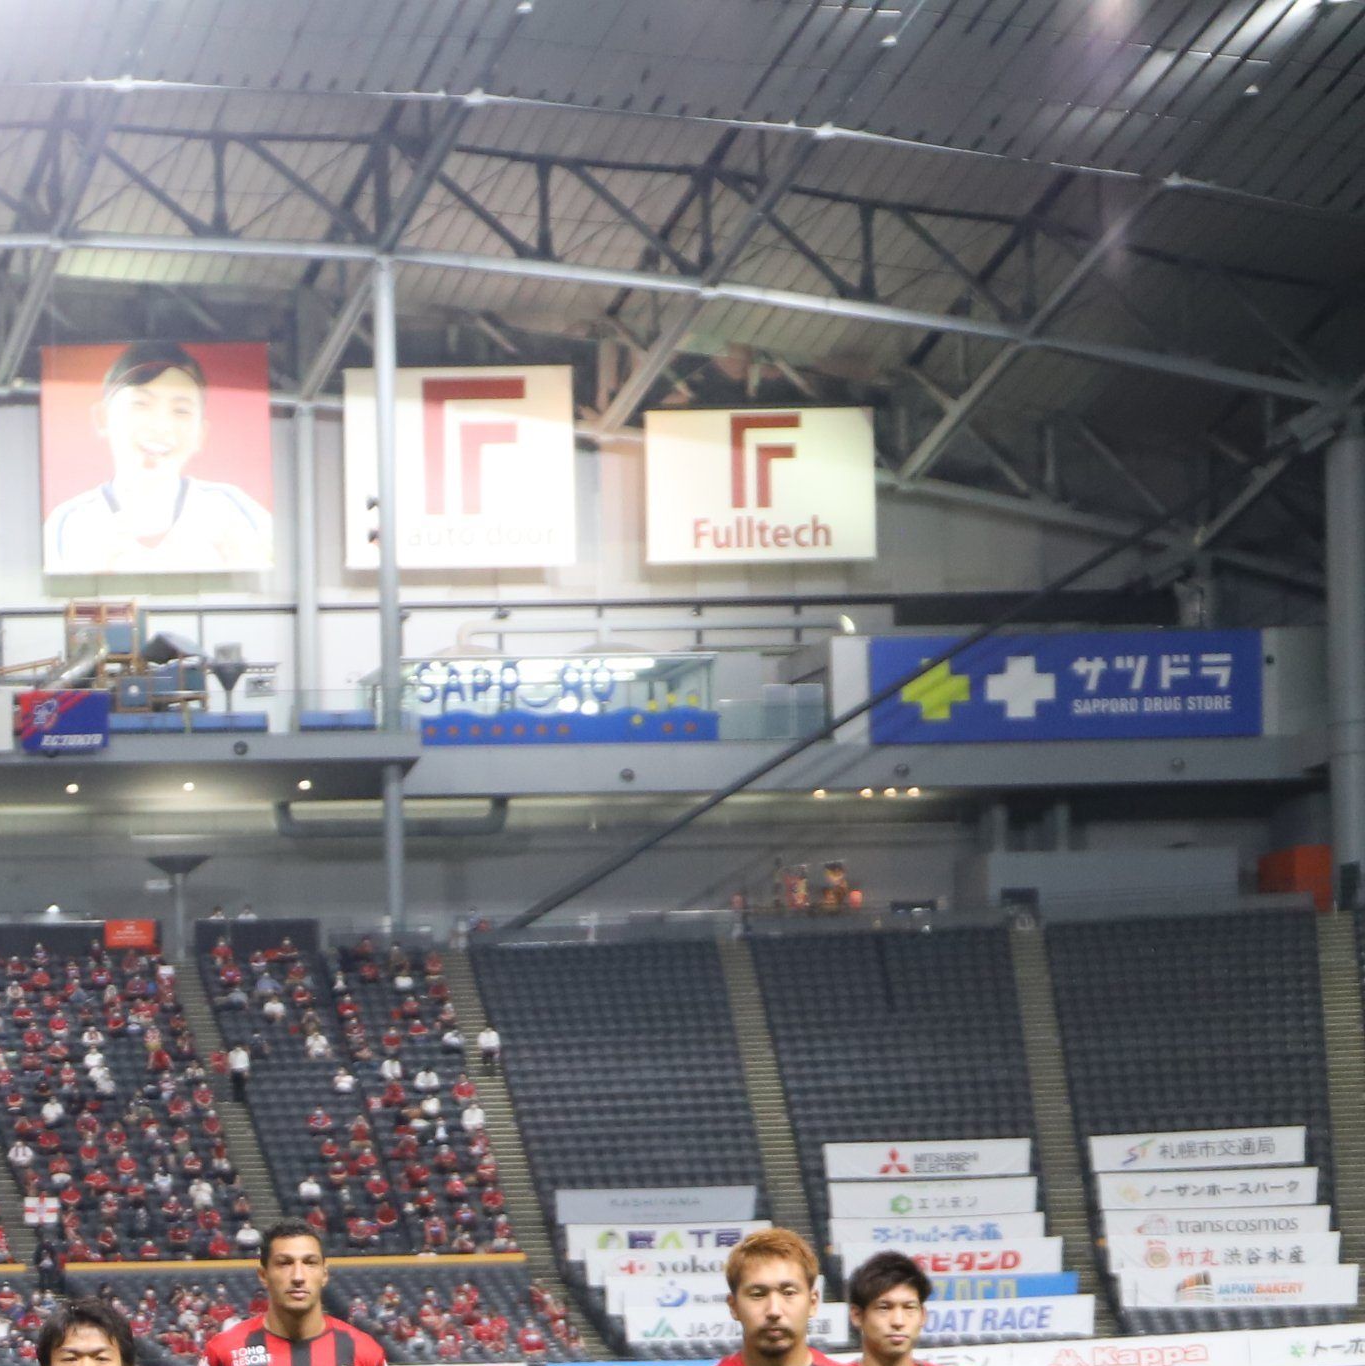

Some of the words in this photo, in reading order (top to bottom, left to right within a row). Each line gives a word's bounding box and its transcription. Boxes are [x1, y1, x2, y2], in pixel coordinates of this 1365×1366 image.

[693, 515, 833, 550] Fulltech
[1072, 653, 1233, 691] サツドラ
[1074, 697, 1139, 714] SAPPORO
[1144, 696, 1182, 712] DRUG
[1187, 695, 1233, 711] STORE
[1159, 1136, 1276, 1159] 札幌市交通局
[914, 1151, 980, 1163] MITSUBISHI
[914, 1162, 969, 1173] ELECTRIC
[1144, 1180, 1300, 1198] ノーザンホースパーク
[1176, 1217, 1300, 1234] transcosmos
[980, 1304, 1054, 1332] RACE
[231, 1345, 266, 1358] TOHO
